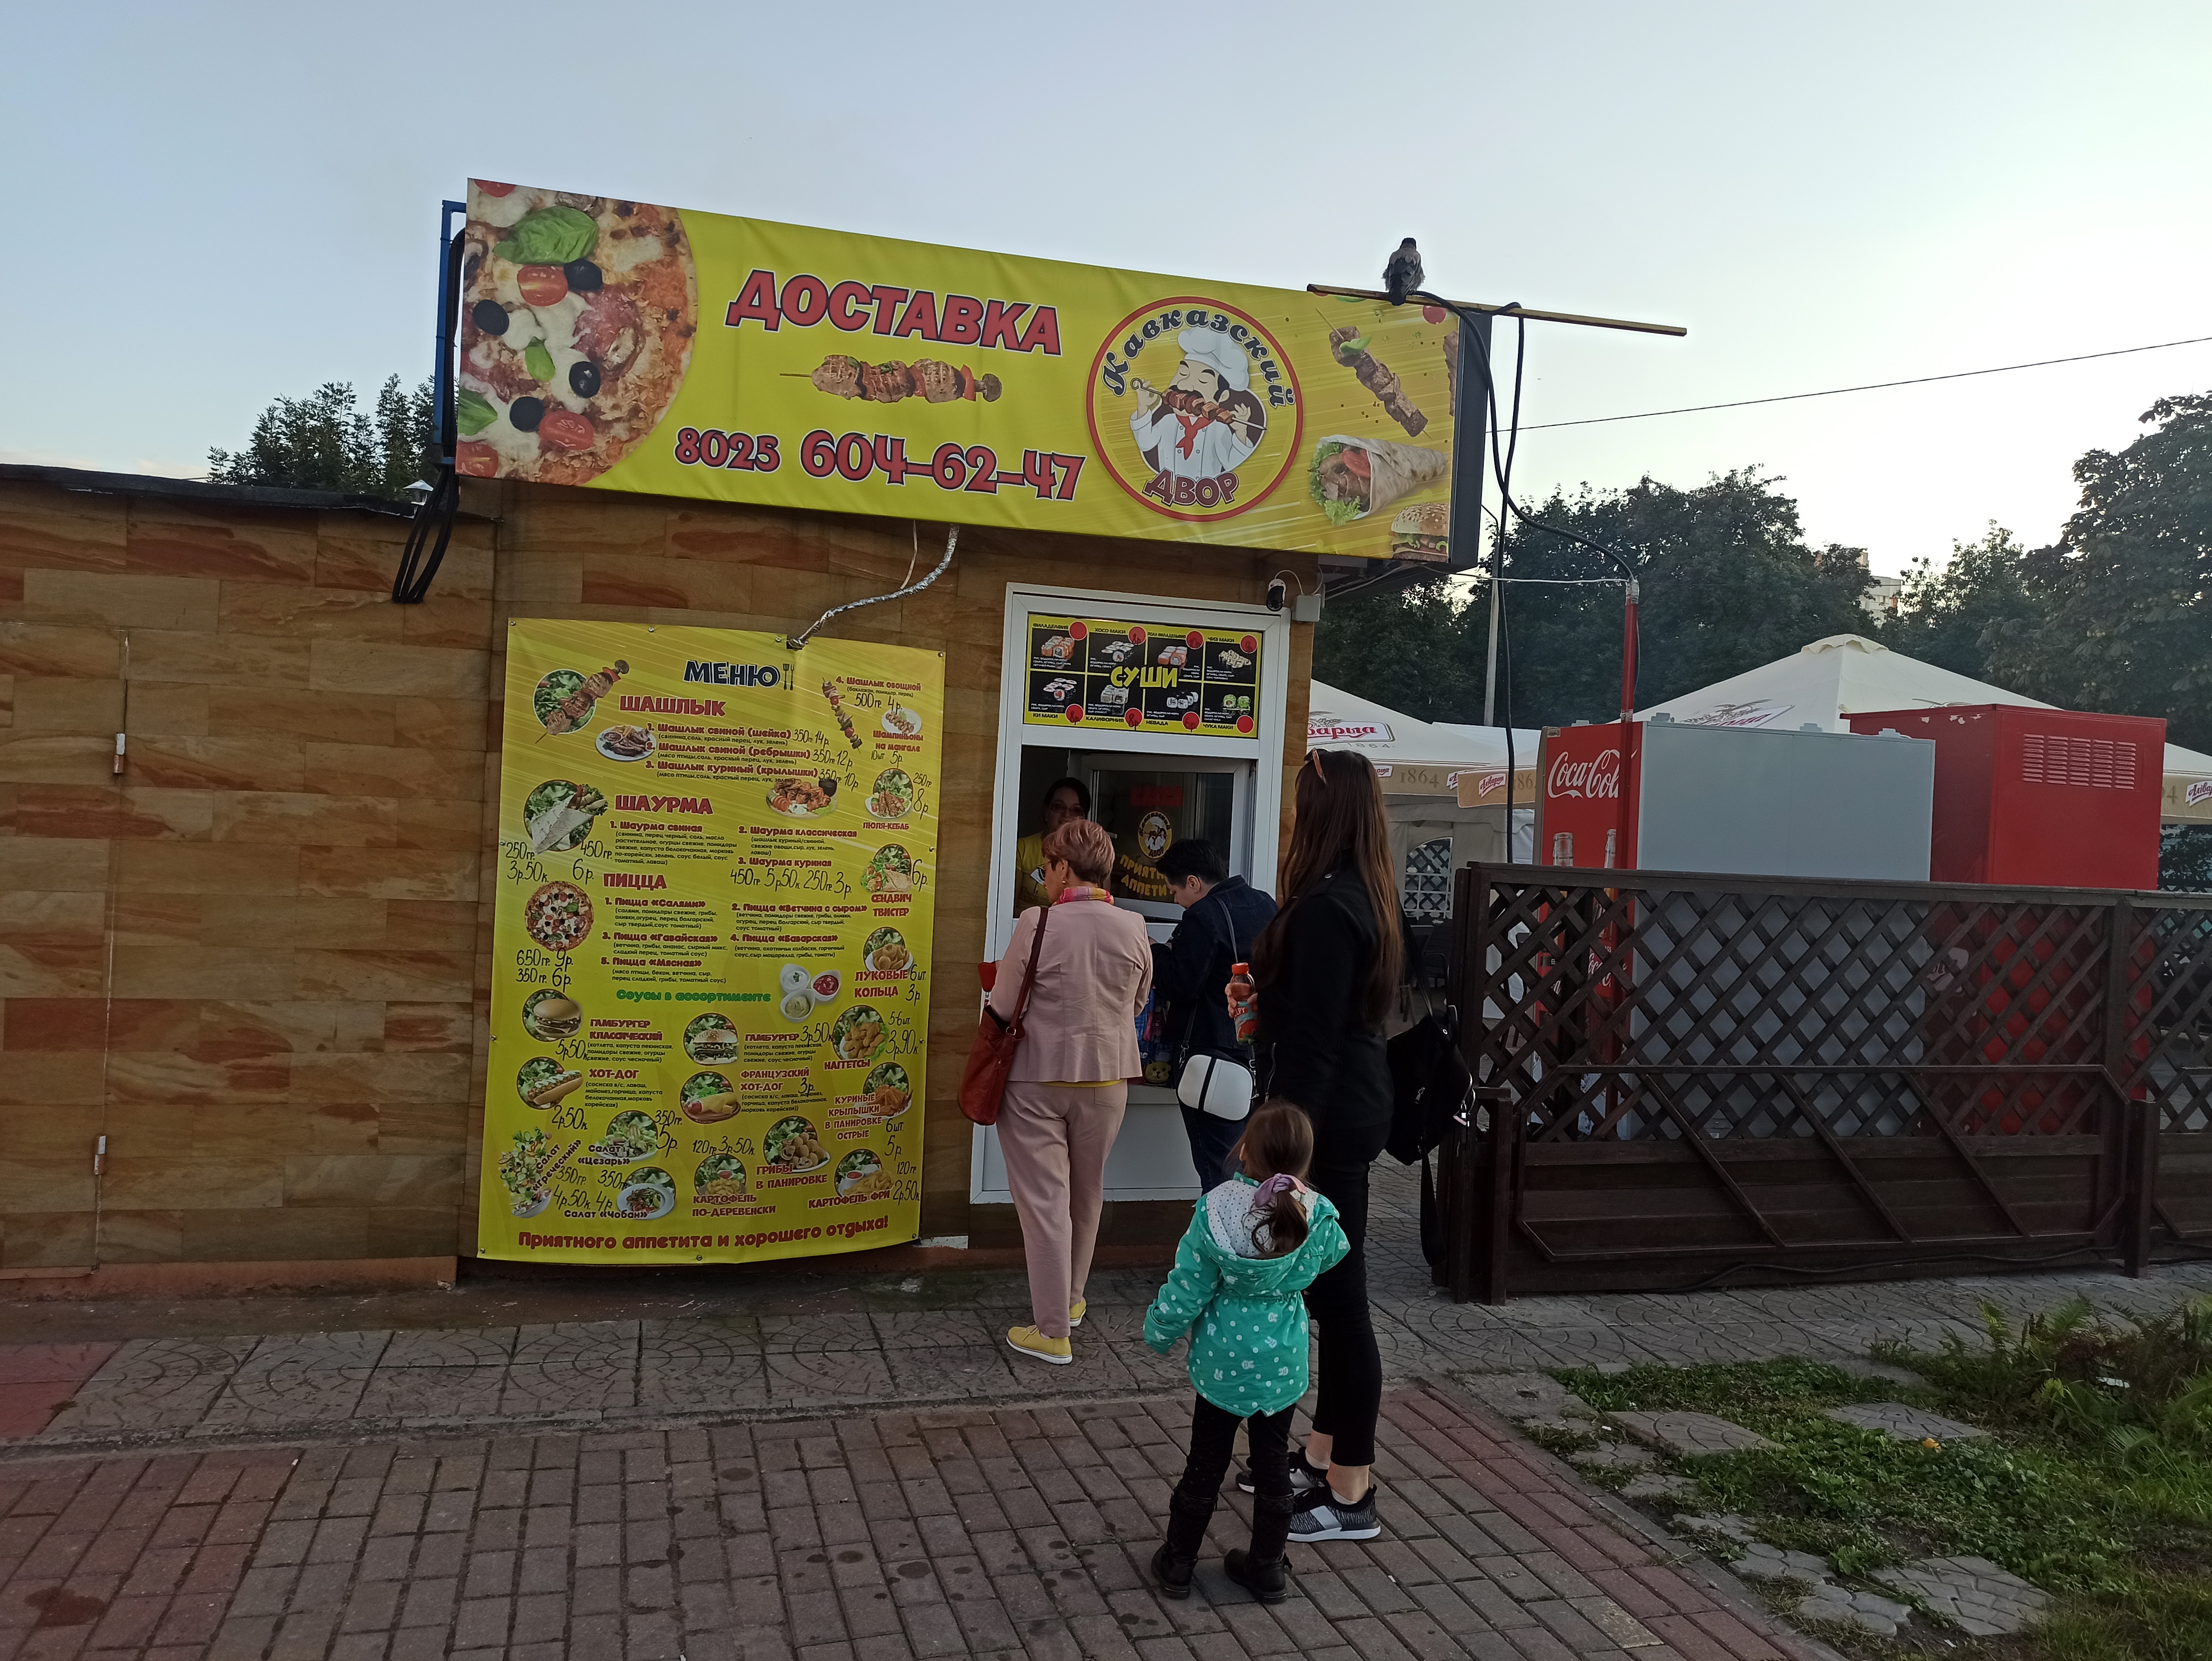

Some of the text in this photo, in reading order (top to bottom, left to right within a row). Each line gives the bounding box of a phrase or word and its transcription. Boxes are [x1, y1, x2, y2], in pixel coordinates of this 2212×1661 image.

[724, 268, 1063, 357] ДОСТАВКА
[1102, 309, 1295, 409] Кавказский
[674, 426, 781, 473] 8025
[1142, 467, 1239, 508] ДВОР
[683, 660, 780, 687] МЕНЮ
[1110, 664, 1178, 689] СУШИ
[836, 676, 921, 691] 4. Шашлык овощной
[619, 696, 727, 717] ШАШЛЫК
[648, 723, 791, 739] 1. Шашлык свиной (шейка)
[873, 730, 923, 741] Шампиньоны
[646, 742, 811, 760] 2. Шашлык свиной (ребрышки)
[888, 744, 920, 752] мангале
[645, 761, 818, 777] 3. Шашлык куриный (крылышки)
[1400, 768, 1440, 788] 1864
[1515, 772, 1536, 790] 86
[615, 794, 714, 815] ШАУРМА
[610, 821, 703, 833] 1. Шаурма свиная
[750, 826, 794, 836] Шаурма
[795, 829, 857, 838] классическая
[863, 822, 909, 830] ЛЮЛЯ-КЕБАБ
[1149, 847, 1164, 857] ДВОР
[749, 857, 793, 867] Шаурма
[795, 859, 831, 868] куриная
[1120, 854, 1165, 879] ПРИЯТН
[603, 873, 667, 891] ПИЦЦА
[1121, 875, 1167, 897] АППЕТИ
[605, 897, 706, 908] 1. Пицца «Салями»
[871, 893, 912, 903] СЕНДВИЧ
[731, 903, 740, 911] 2.
[743, 903, 775, 913] Пицца
[778, 904, 822, 913] «Ветчина
[832, 904, 867, 914] сыром»
[873, 908, 909, 918] ТВИСТЕР
[614, 932, 647, 942] Пицца
[650, 933, 718, 942] «Гавайская»
[730, 934, 838, 944] 4. Пицца «Баварская»
[601, 957, 702, 967] 5. Пицца «Мясная»
[855, 970, 908, 982] ЛУКОВЫЕ
[617, 990, 771, 1004] Соусы в ассортименте
[854, 986, 898, 998] КОЛЬЦА
[1235, 1007, 1245, 1015] LPY
[590, 1019, 651, 1028] ГАМБУРГЕР
[745, 1033, 800, 1043] ГАМБУРГЕР
[824, 1059, 870, 1070] НАГГЕТСЫ
[588, 1068, 640, 1079] ХОТ-ДОГ
[741, 1067, 810, 1080] ФРАНЦУЗСКИЙ
[740, 1082, 784, 1092] ХОТ-ДОГ
[835, 1093, 876, 1105] КУРИНЫЕ
[829, 1104, 881, 1118] КРЫЛЫШКИ
[825, 1117, 882, 1129] В ПАНИРОВКЕ
[837, 1130, 870, 1141] ОСТРЫЕ
[588, 1145, 621, 1153] Салат
[536, 1144, 561, 1171] Салат
[577, 1157, 630, 1166] «Цезарь»
[532, 1139, 582, 1191] «Греческий»
[756, 1163, 794, 1175] ГРИБЫ
[756, 1174, 828, 1189] В ПАНИРОВКЕ
[693, 1194, 757, 1204] КАРТОФЕЛЬ
[808, 1189, 890, 1209] КАРТОФЕЛЬ ФРИ
[564, 1210, 597, 1218] Салат
[692, 1205, 776, 1218] ПО-ДЕРЕВЕНСКИ
[518, 1215, 888, 1250] Приятного аппетита и хорошего отдыха!
